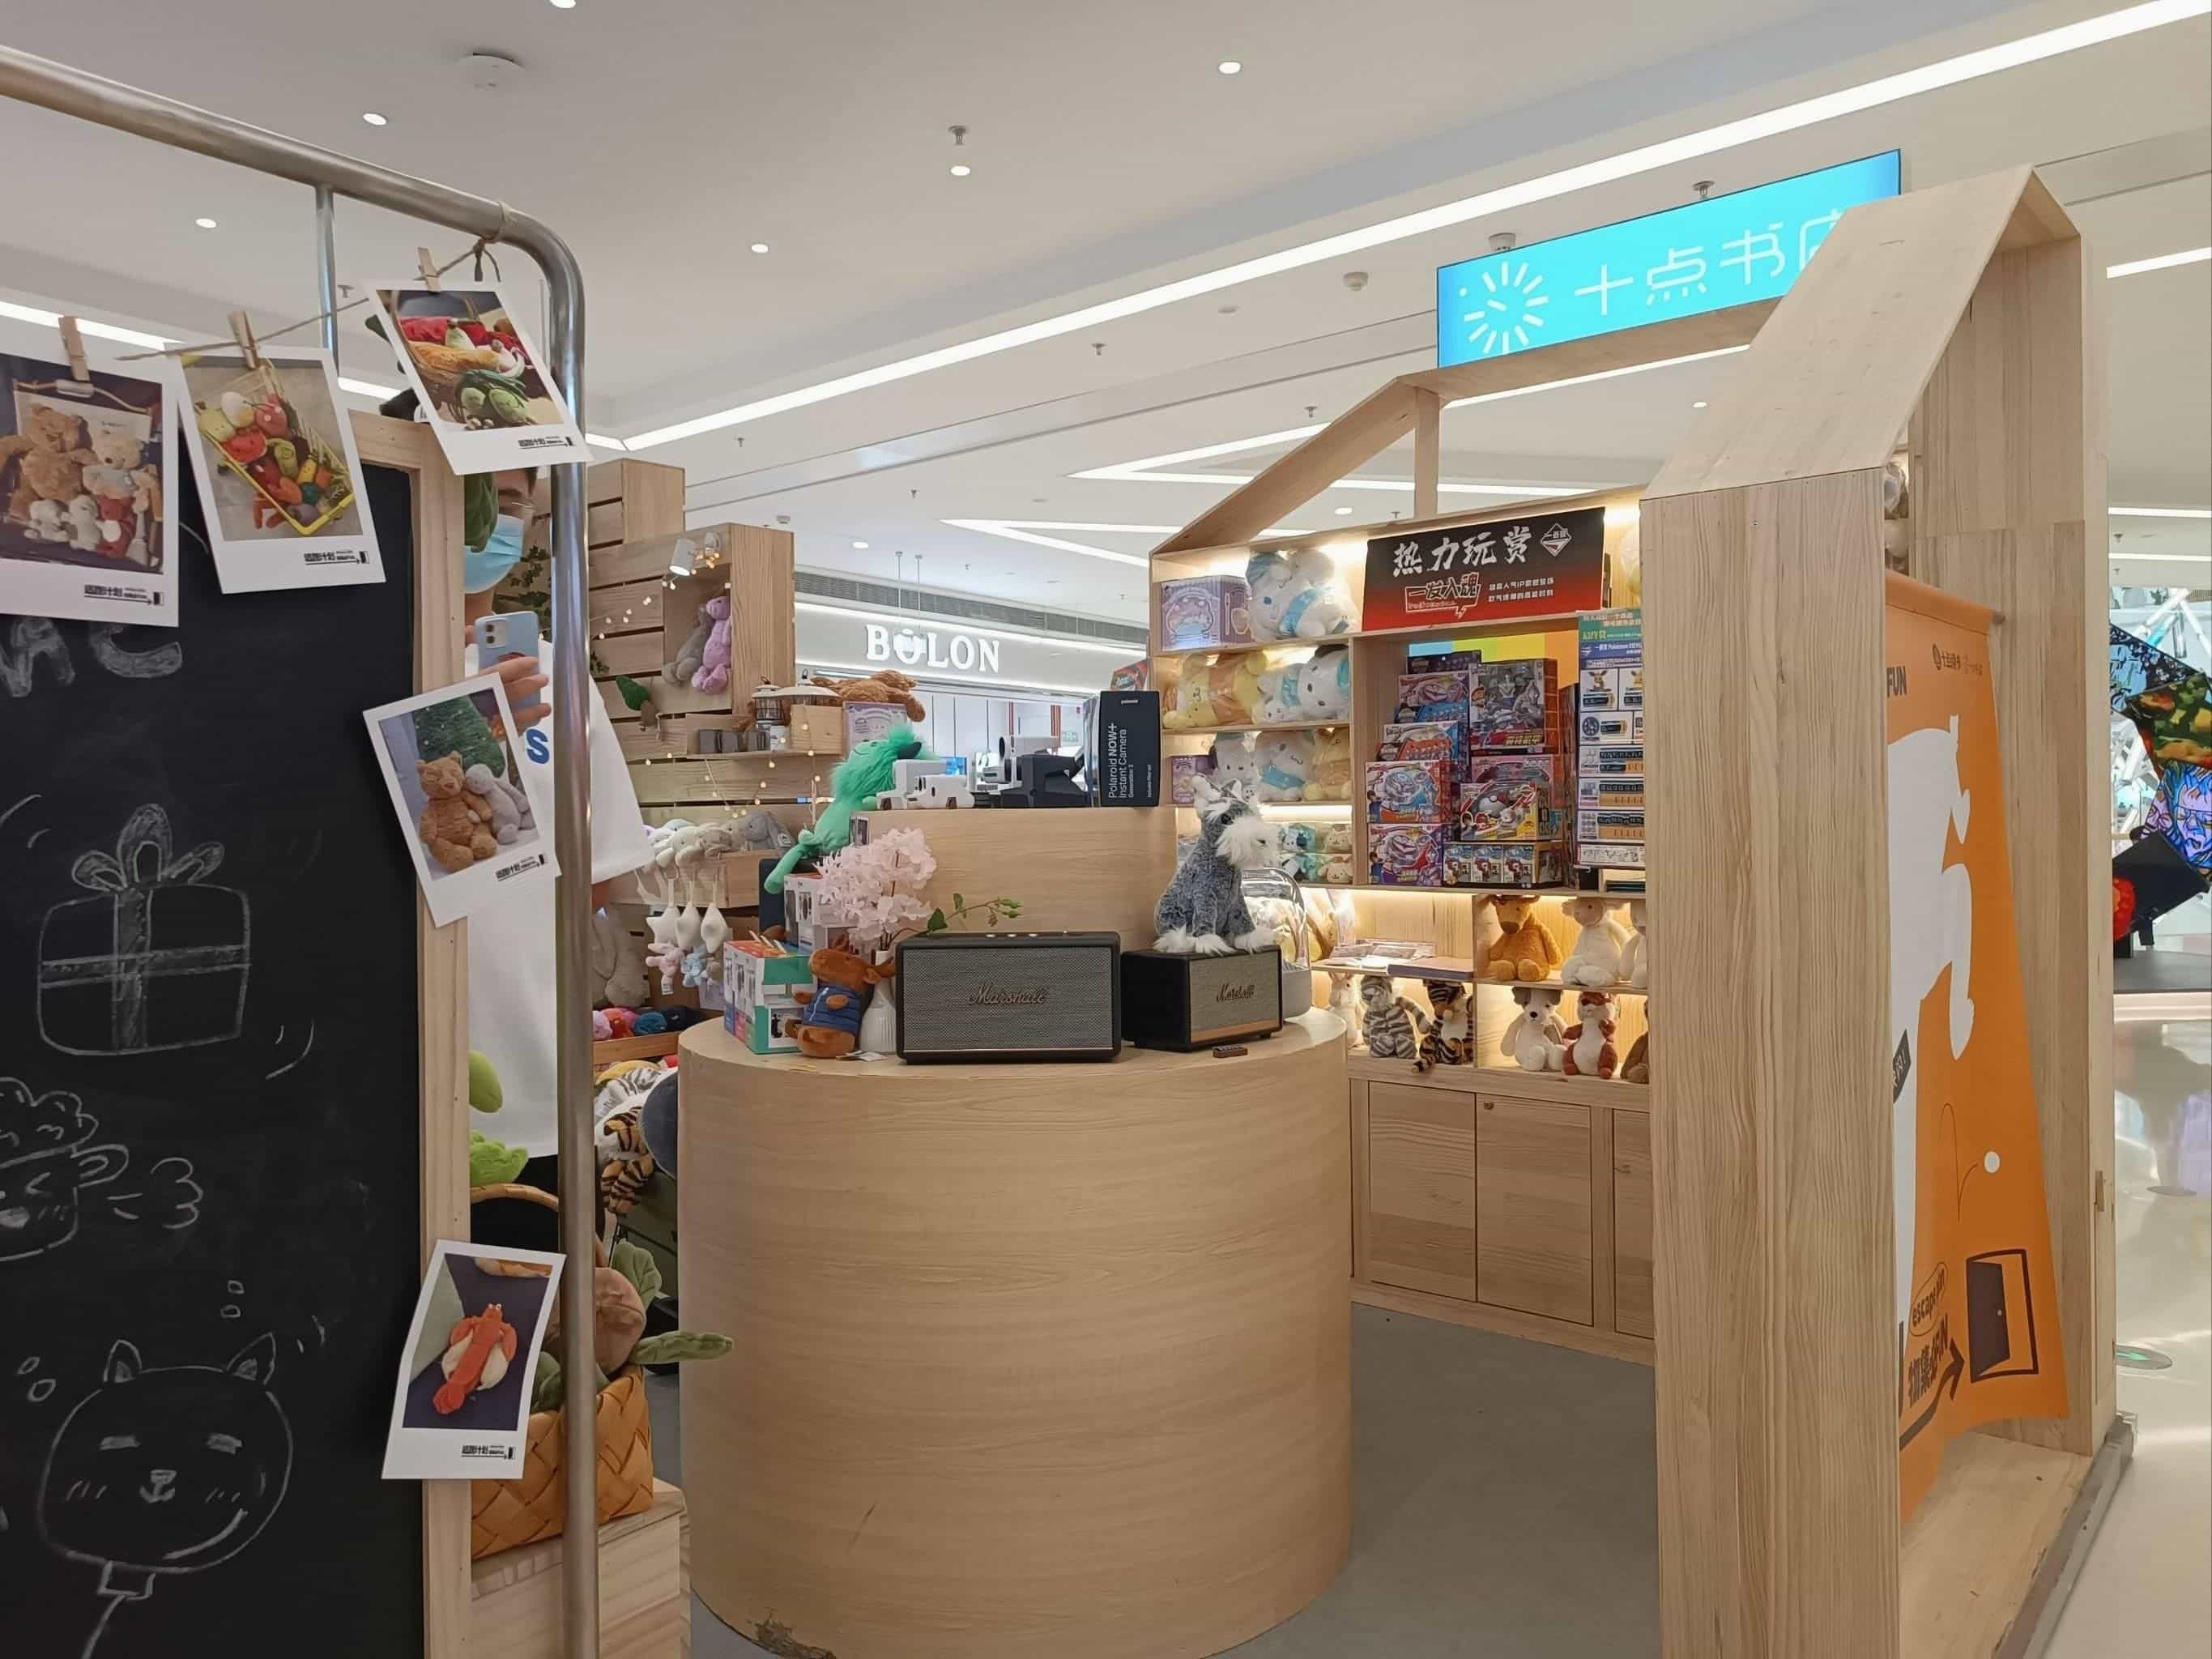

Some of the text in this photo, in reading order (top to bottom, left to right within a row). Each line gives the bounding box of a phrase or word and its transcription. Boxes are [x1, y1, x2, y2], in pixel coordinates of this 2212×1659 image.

[1392, 525, 1532, 577] 热力玩赏
[1409, 572, 1481, 599] 一发入魂
[866, 624, 999, 674] BOLON
[1886, 665, 1907, 698] FUN
[1108, 722, 1118, 798] Polaroid NOW+
[1118, 729, 1127, 798] Instant Camera
[967, 983, 1051, 1005] Marshall
